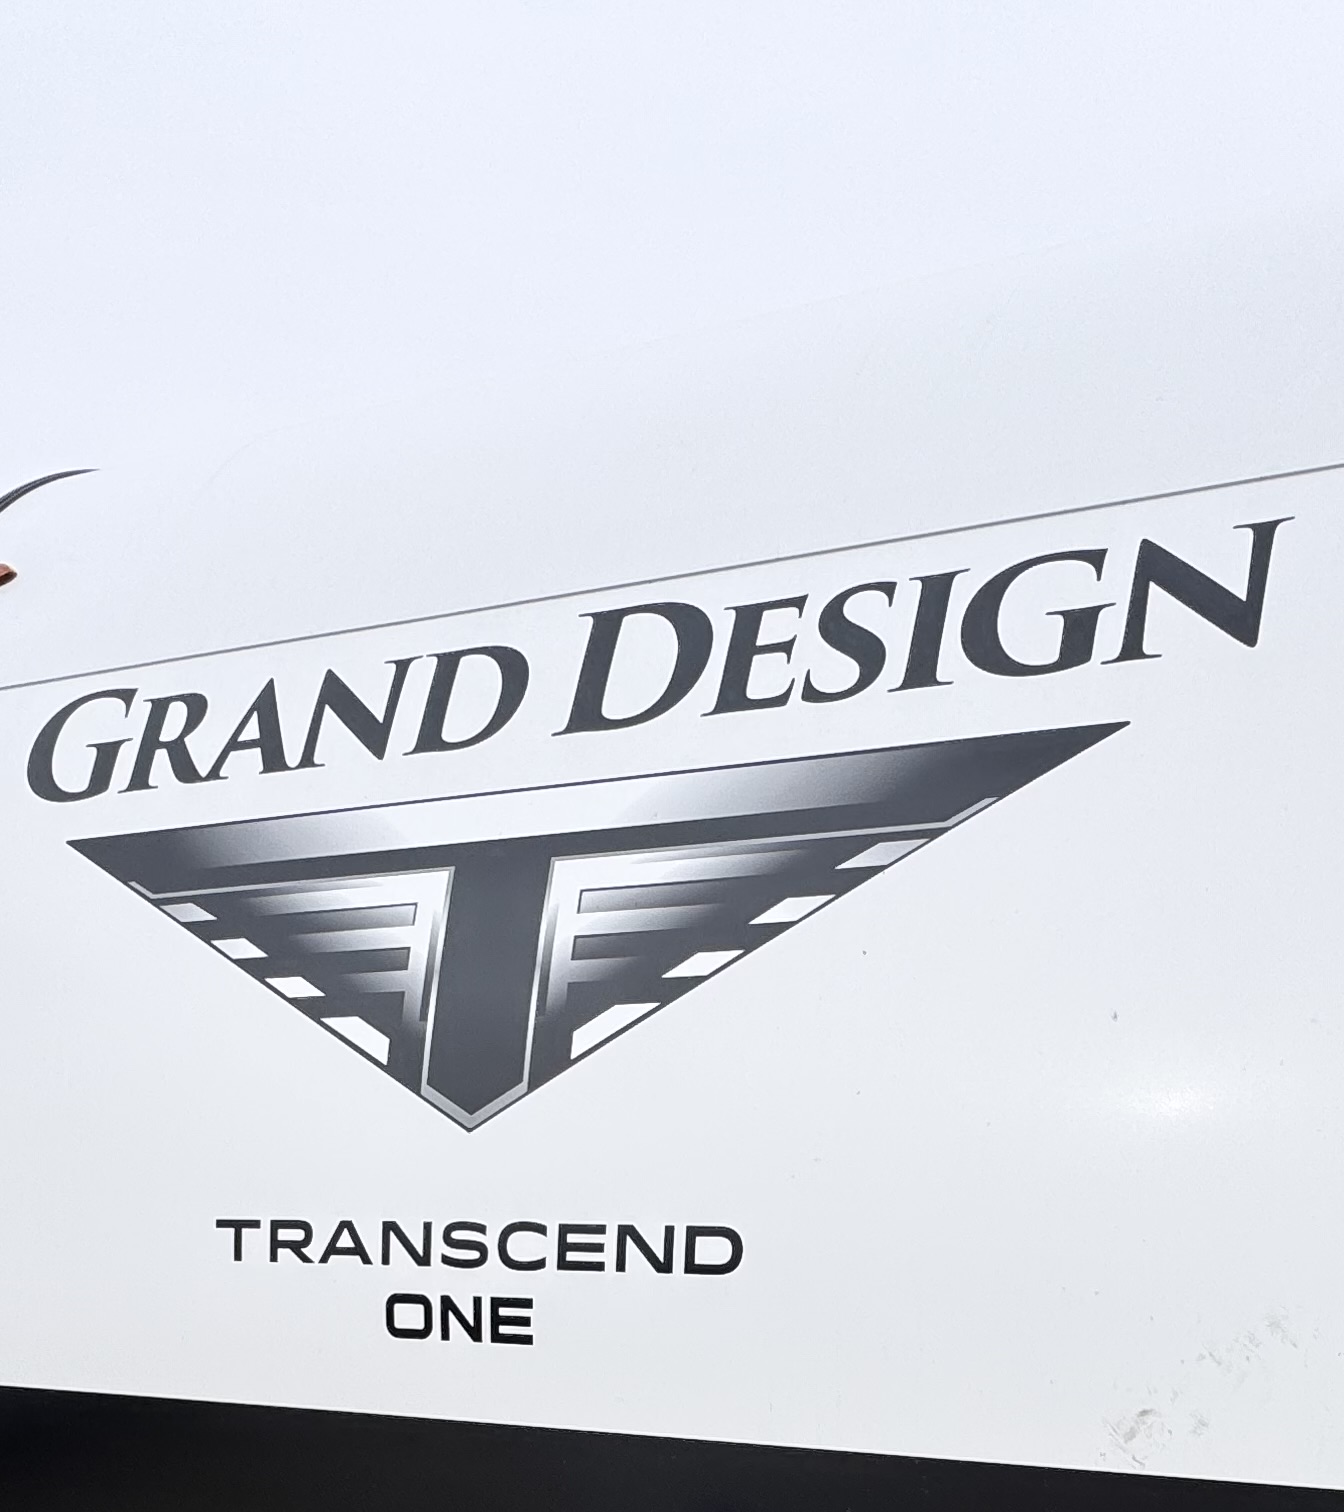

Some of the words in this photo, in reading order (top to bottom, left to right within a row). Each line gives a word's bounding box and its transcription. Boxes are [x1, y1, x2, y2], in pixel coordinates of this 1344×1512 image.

[26, 645, 530, 804] GRAND
[551, 517, 1294, 738] DESIGN
[216, 1219, 744, 1277] TRANSCEND
[385, 1293, 534, 1346] ONE
